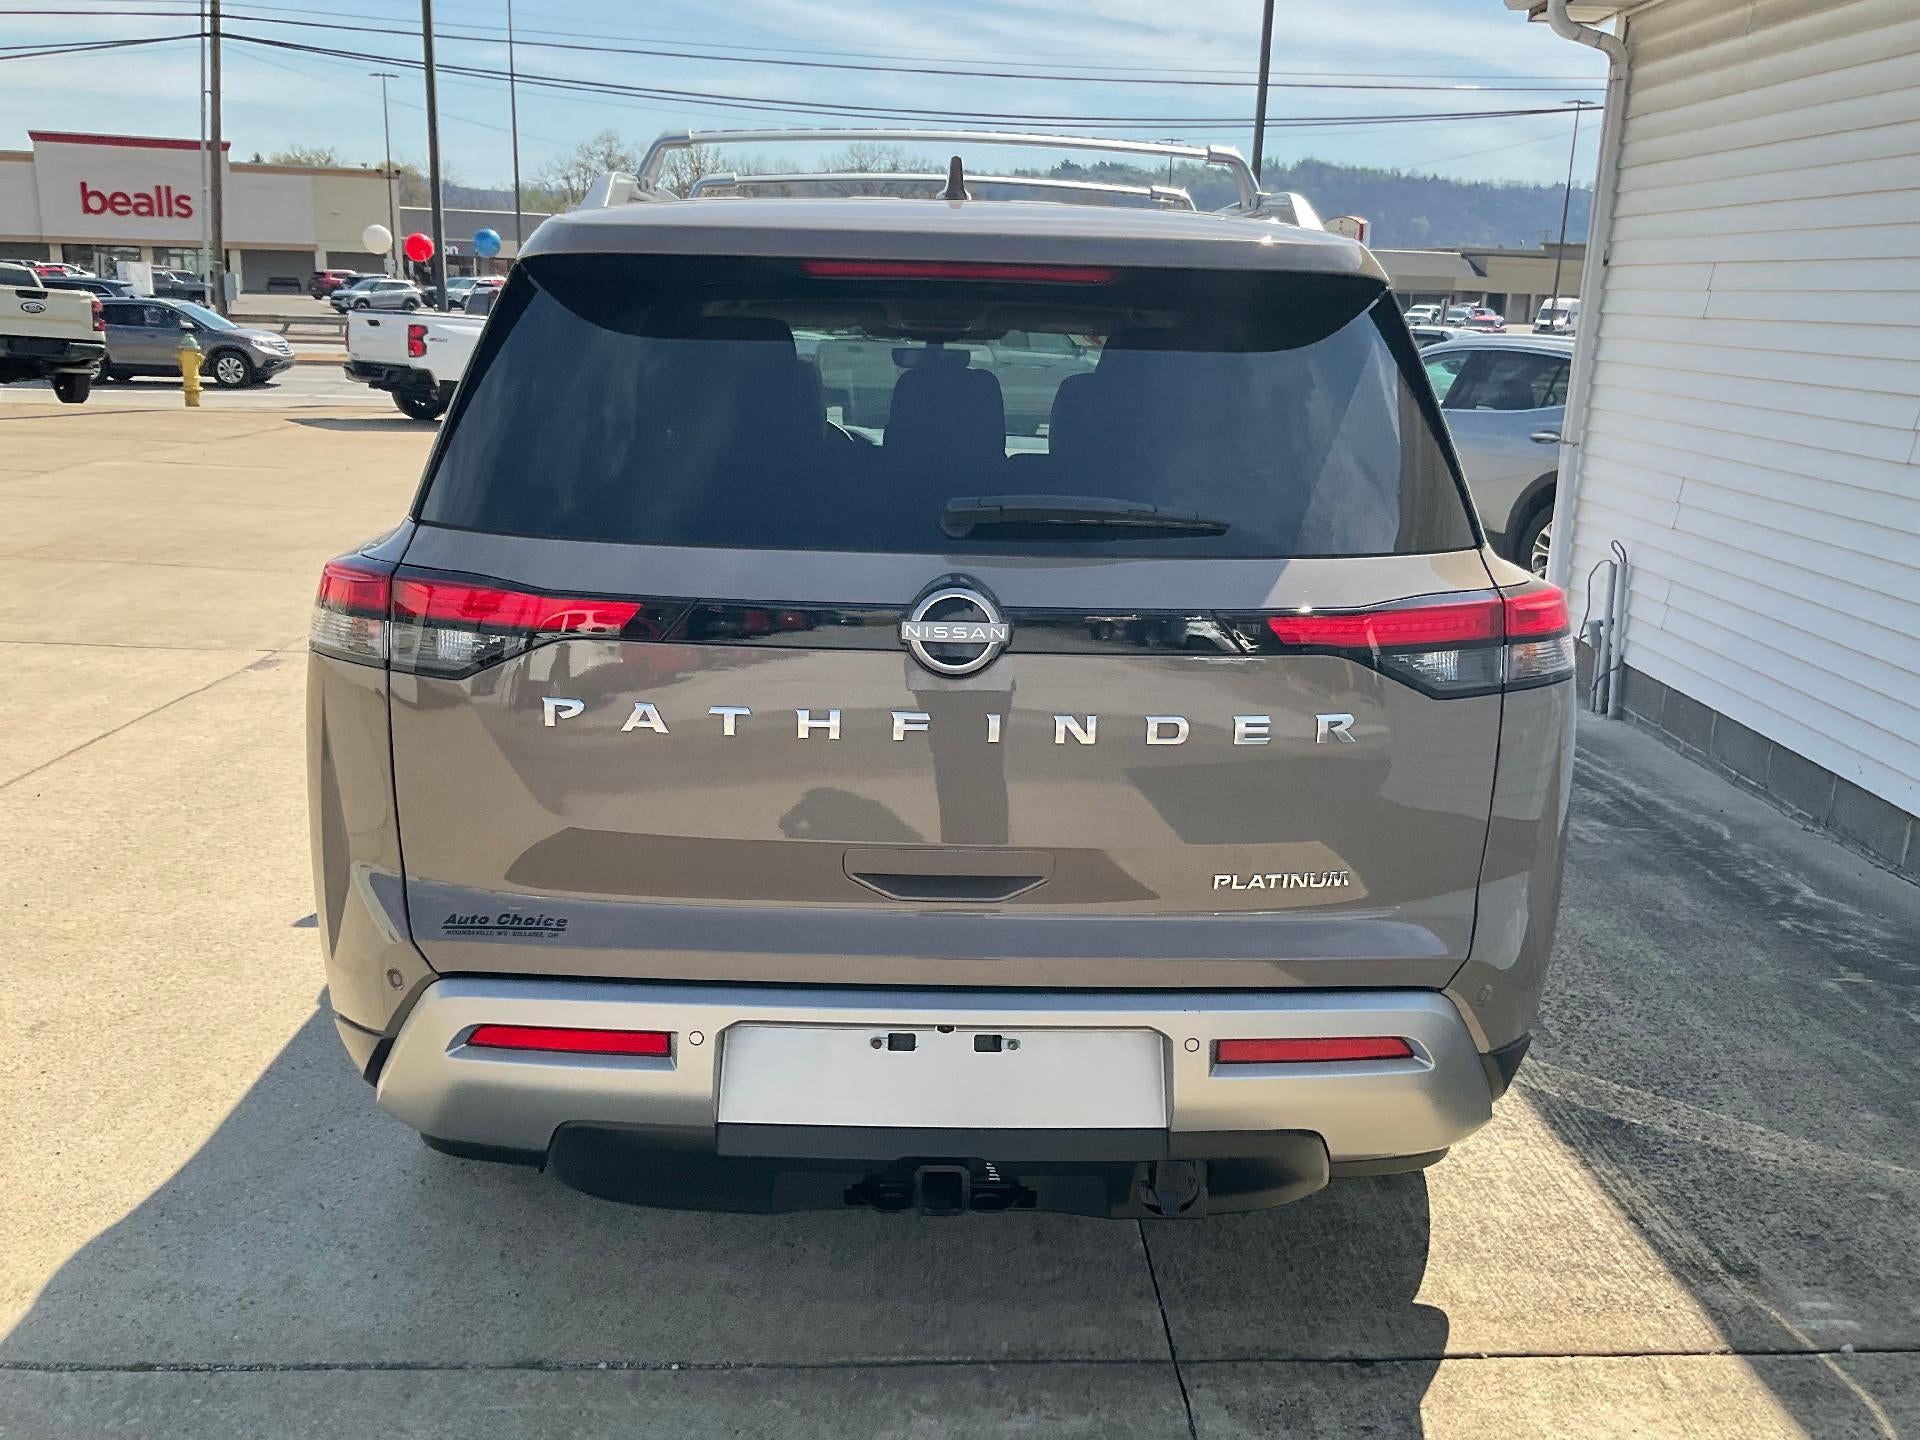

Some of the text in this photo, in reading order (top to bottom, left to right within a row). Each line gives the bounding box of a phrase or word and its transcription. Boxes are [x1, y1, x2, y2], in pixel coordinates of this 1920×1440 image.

[80, 181, 193, 218] bealls
[905, 624, 1005, 639] NISSAN
[541, 696, 1357, 746] PATHFINDER
[1213, 870, 1349, 890] PLATINUM
[442, 913, 568, 927] Auto Choice
